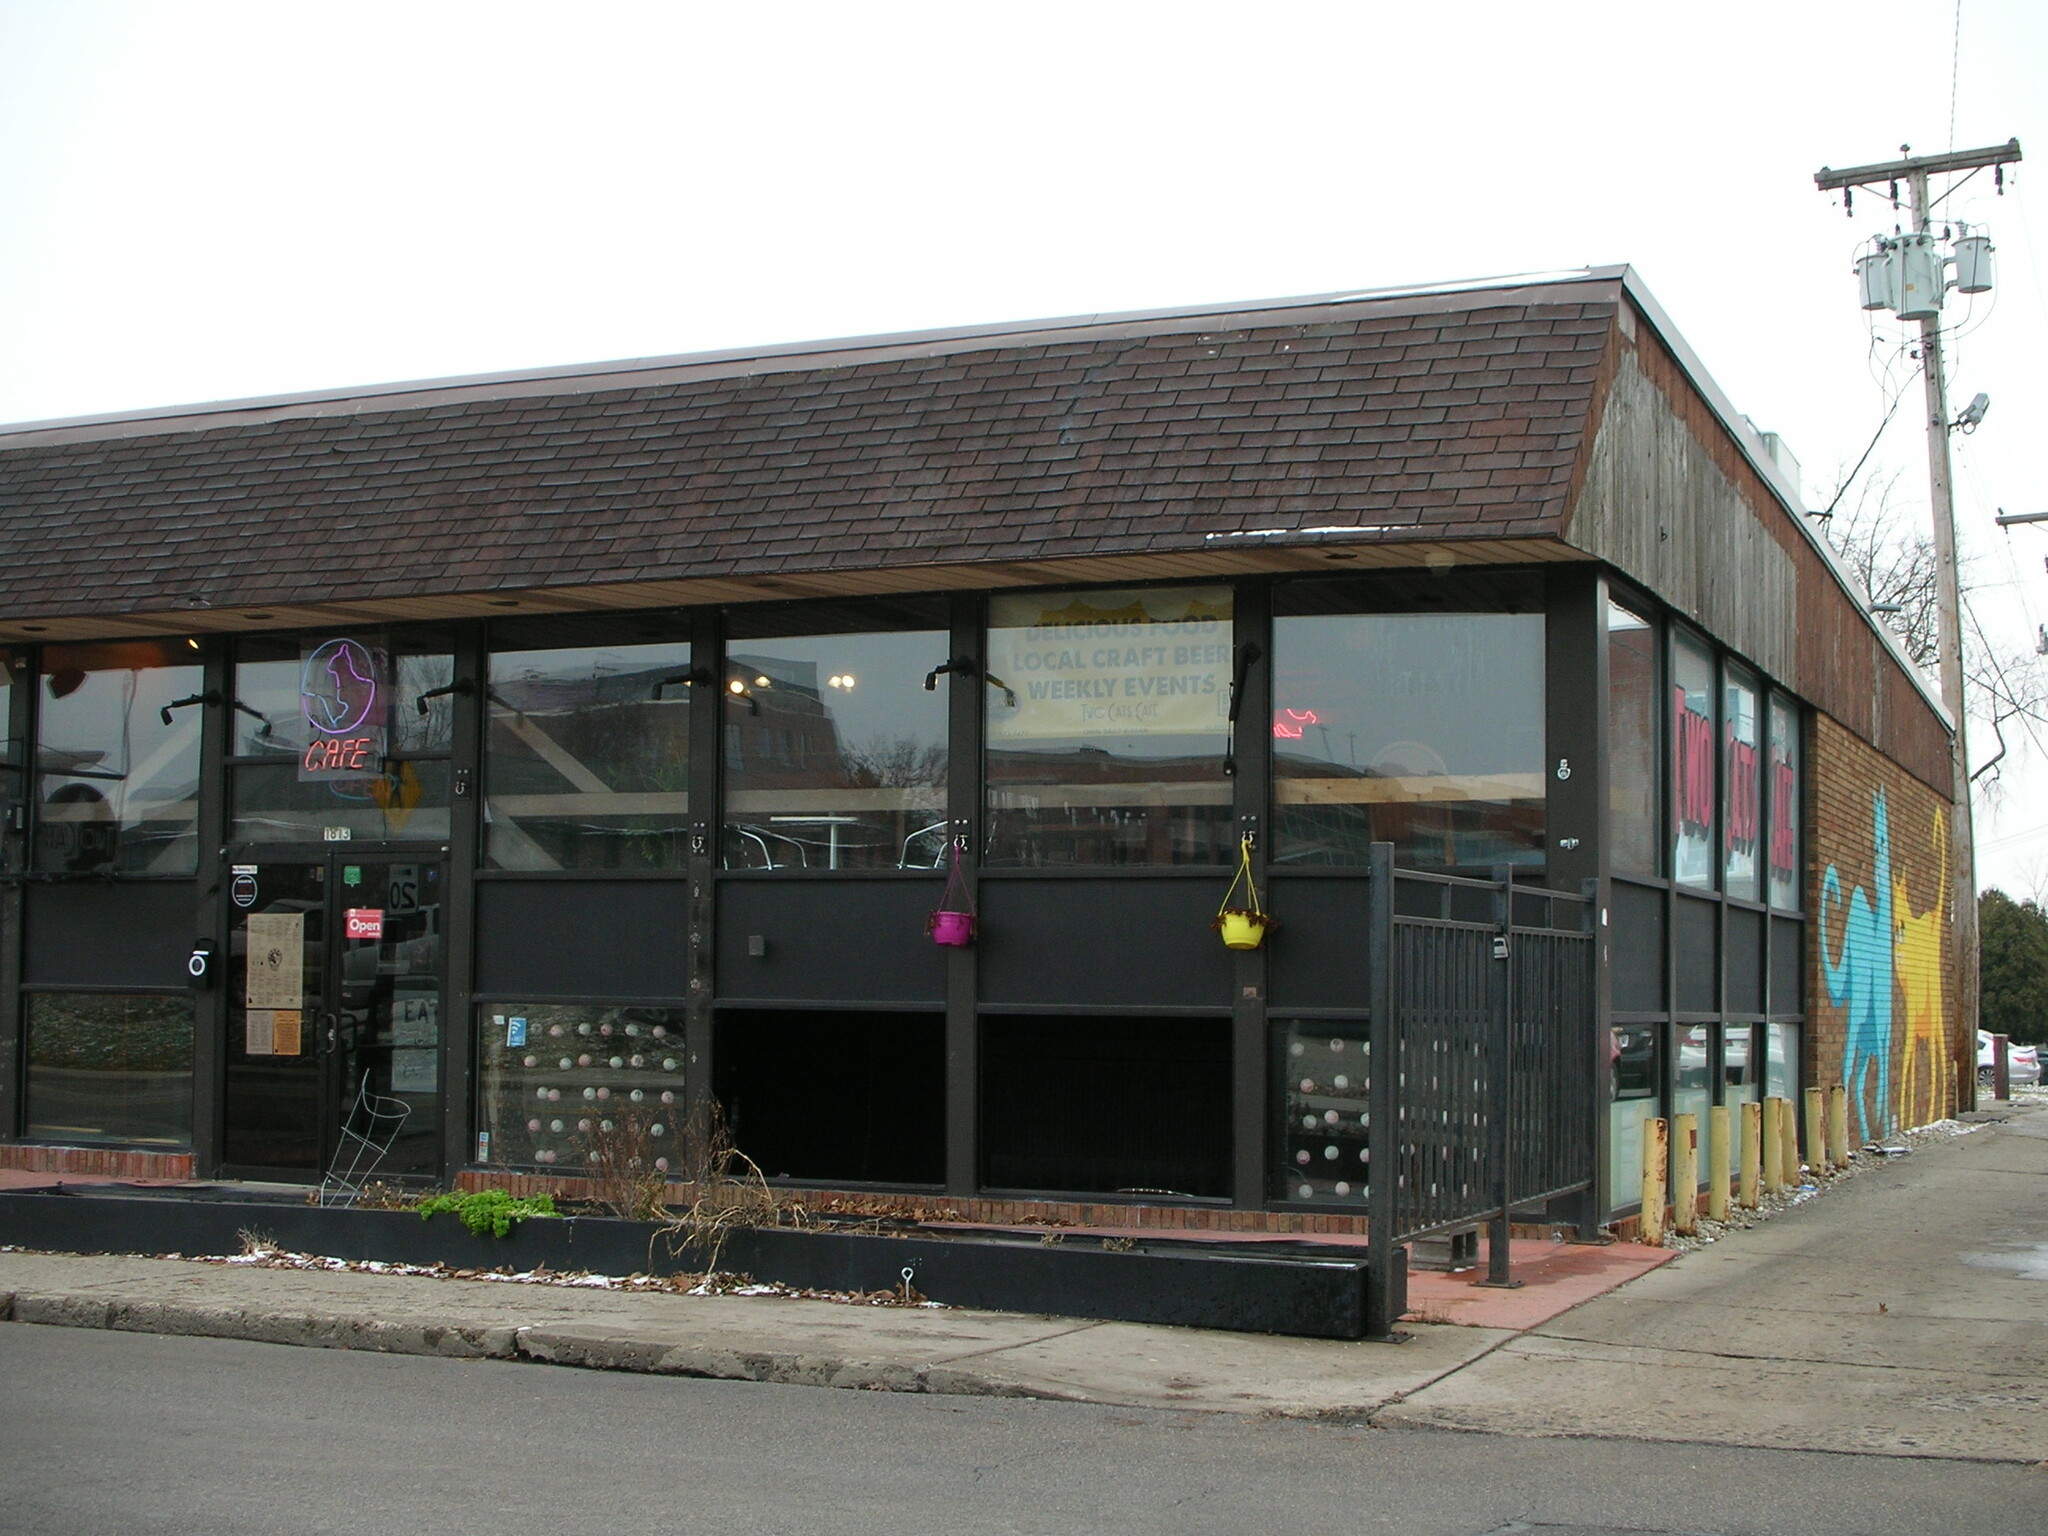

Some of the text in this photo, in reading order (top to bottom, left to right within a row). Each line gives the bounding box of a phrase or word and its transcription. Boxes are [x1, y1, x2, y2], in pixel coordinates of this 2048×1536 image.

[1026, 613, 1218, 643] DELICIOUS FOOD
[1013, 644, 1231, 672] LOCAL CRAFT BEER
[1028, 674, 1217, 700] WEEKLY EVENTS
[304, 738, 371, 772] CAFE
[1674, 684, 1711, 841] TWO
[325, 827, 350, 839] 1813
[350, 918, 381, 933] Open
